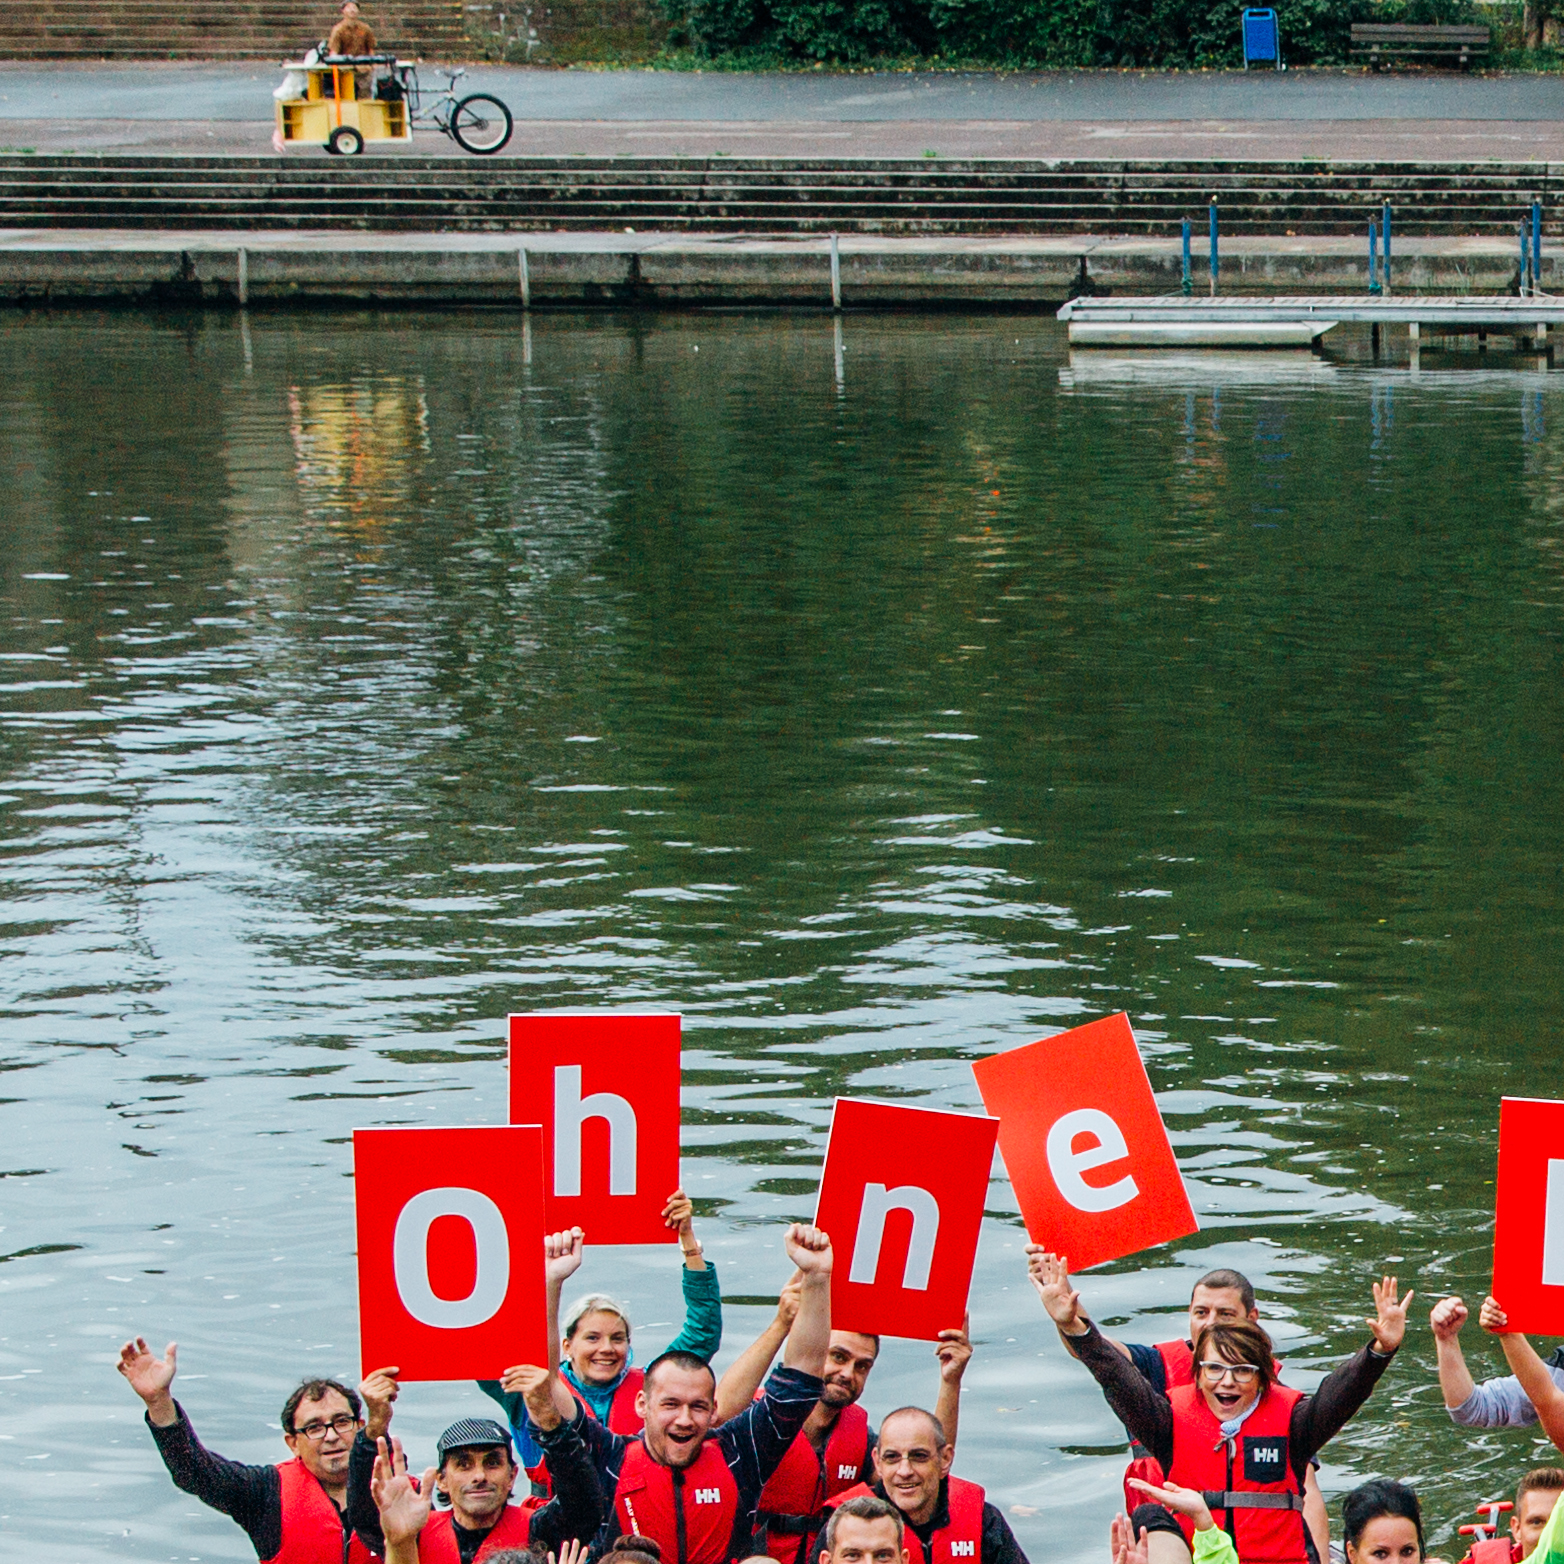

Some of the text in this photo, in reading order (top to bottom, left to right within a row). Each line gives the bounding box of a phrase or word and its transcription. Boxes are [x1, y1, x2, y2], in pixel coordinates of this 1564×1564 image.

[554, 1065, 637, 1197] h
[1046, 1108, 1140, 1213] e
[849, 1182, 940, 1291] n
[1254, 1447, 1279, 1463] HH
[838, 1464, 857, 1480] HH
[695, 1488, 721, 1505] HH
[951, 1540, 975, 1557] HH
